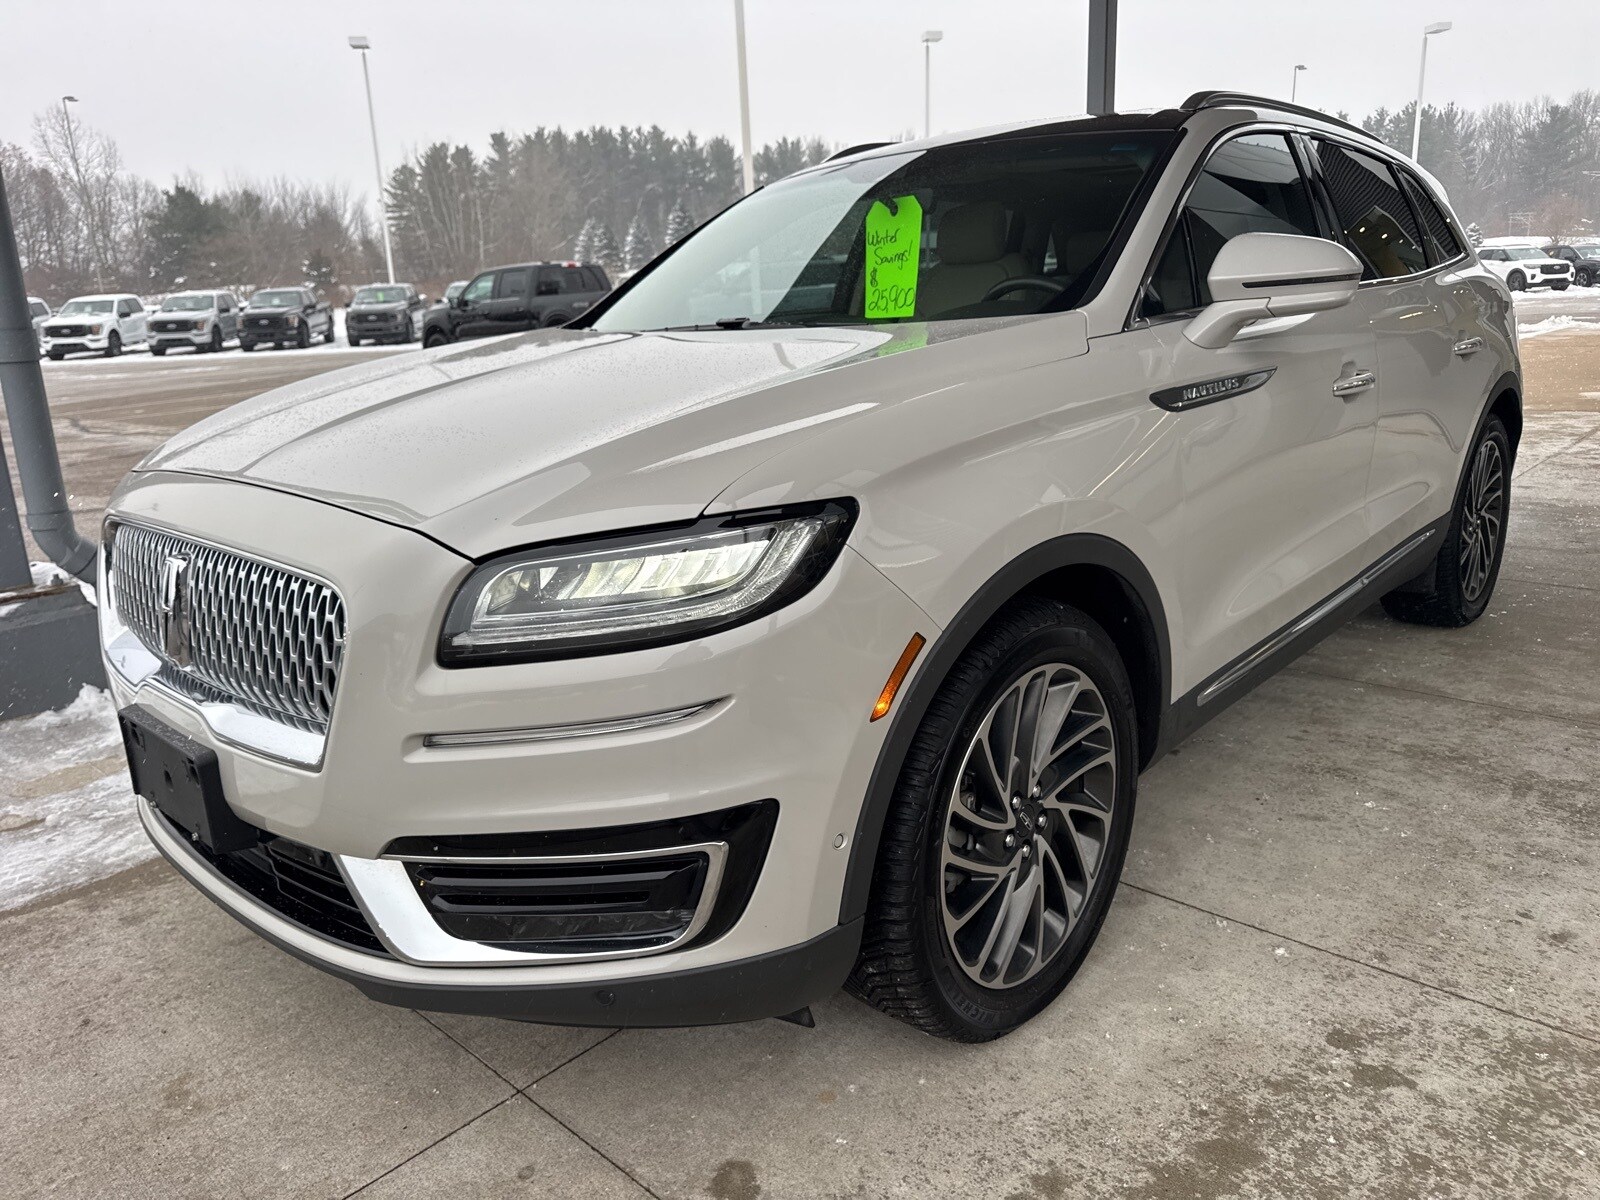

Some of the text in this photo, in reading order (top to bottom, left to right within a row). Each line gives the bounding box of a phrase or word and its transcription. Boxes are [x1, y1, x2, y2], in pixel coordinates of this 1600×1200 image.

[867, 228, 900, 247] Winter
[874, 240, 914, 271] Savings!
[869, 267, 879, 288] $
[868, 284, 915, 314] 25,900
[1183, 378, 1240, 401] NAUTILUS
